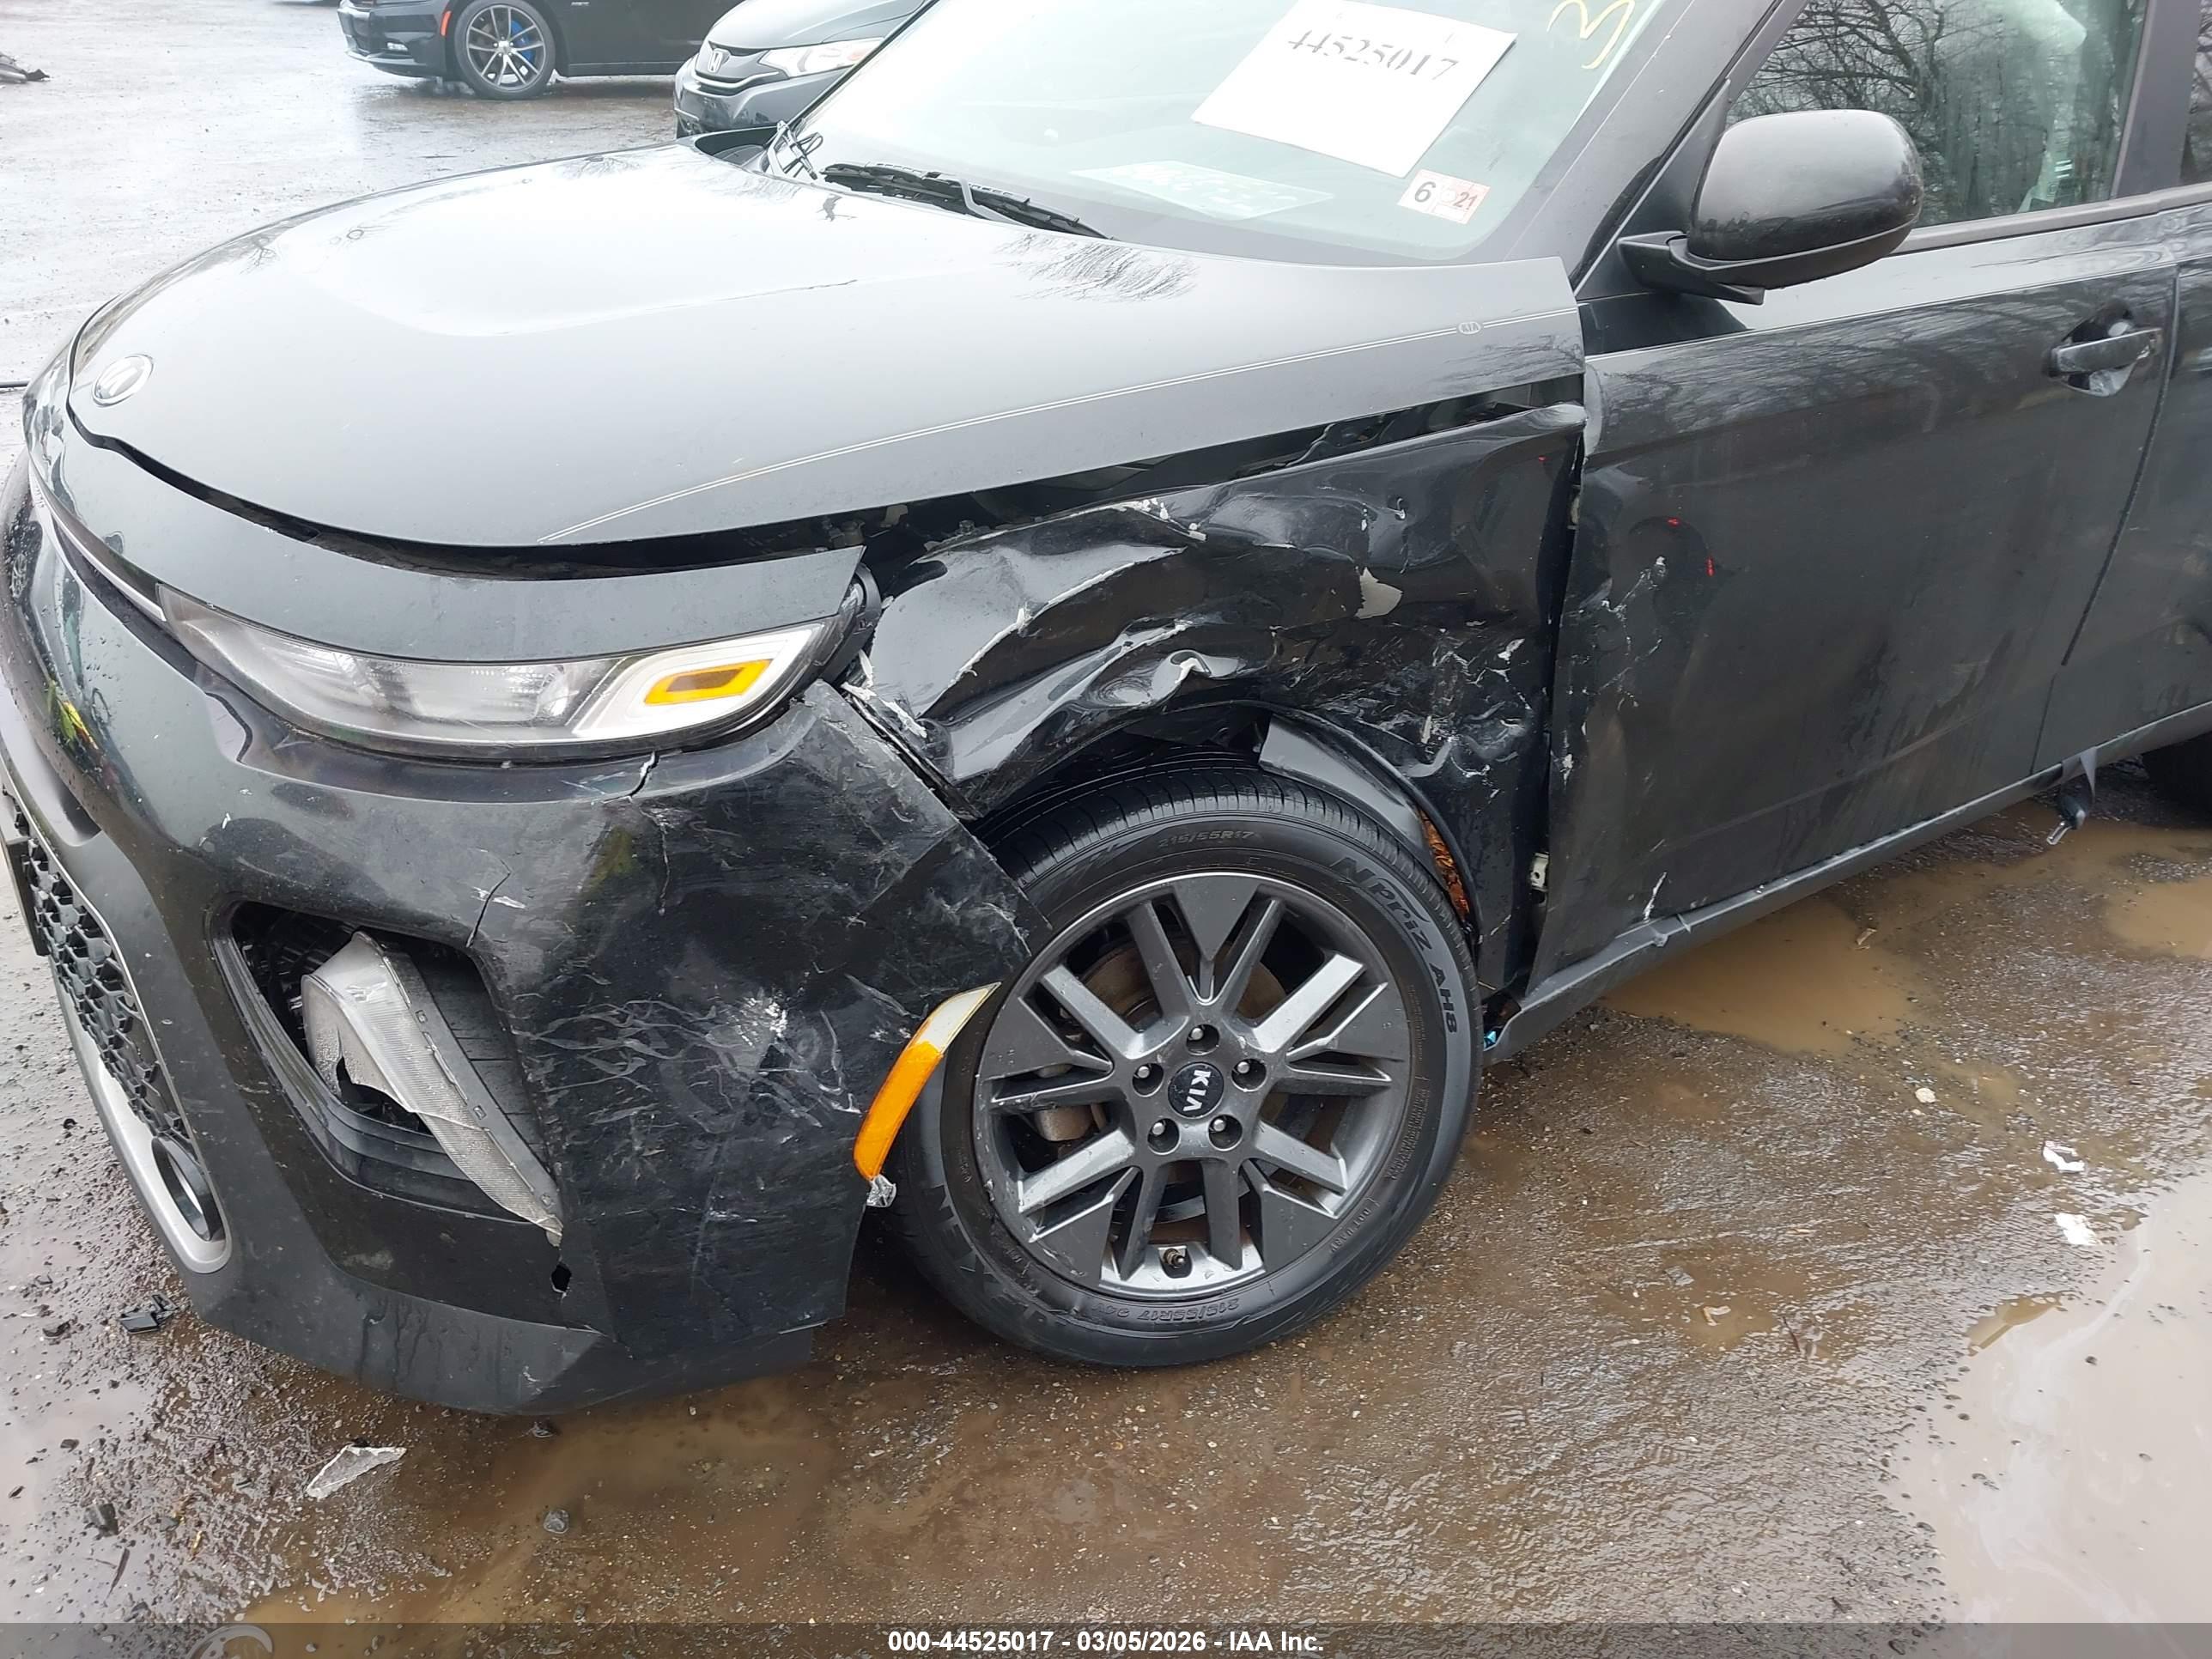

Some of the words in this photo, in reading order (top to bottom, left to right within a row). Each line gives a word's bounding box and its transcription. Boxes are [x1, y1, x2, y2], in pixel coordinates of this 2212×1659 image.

[1287, 27, 1461, 82] 44525017
[1413, 180, 1436, 203] 6
[1453, 191, 1479, 210] 21
[1429, 961, 1457, 1034] AH8
[1182, 1069, 1212, 1112] KIA
[1136, 1297, 1240, 1322] 215/55R17
